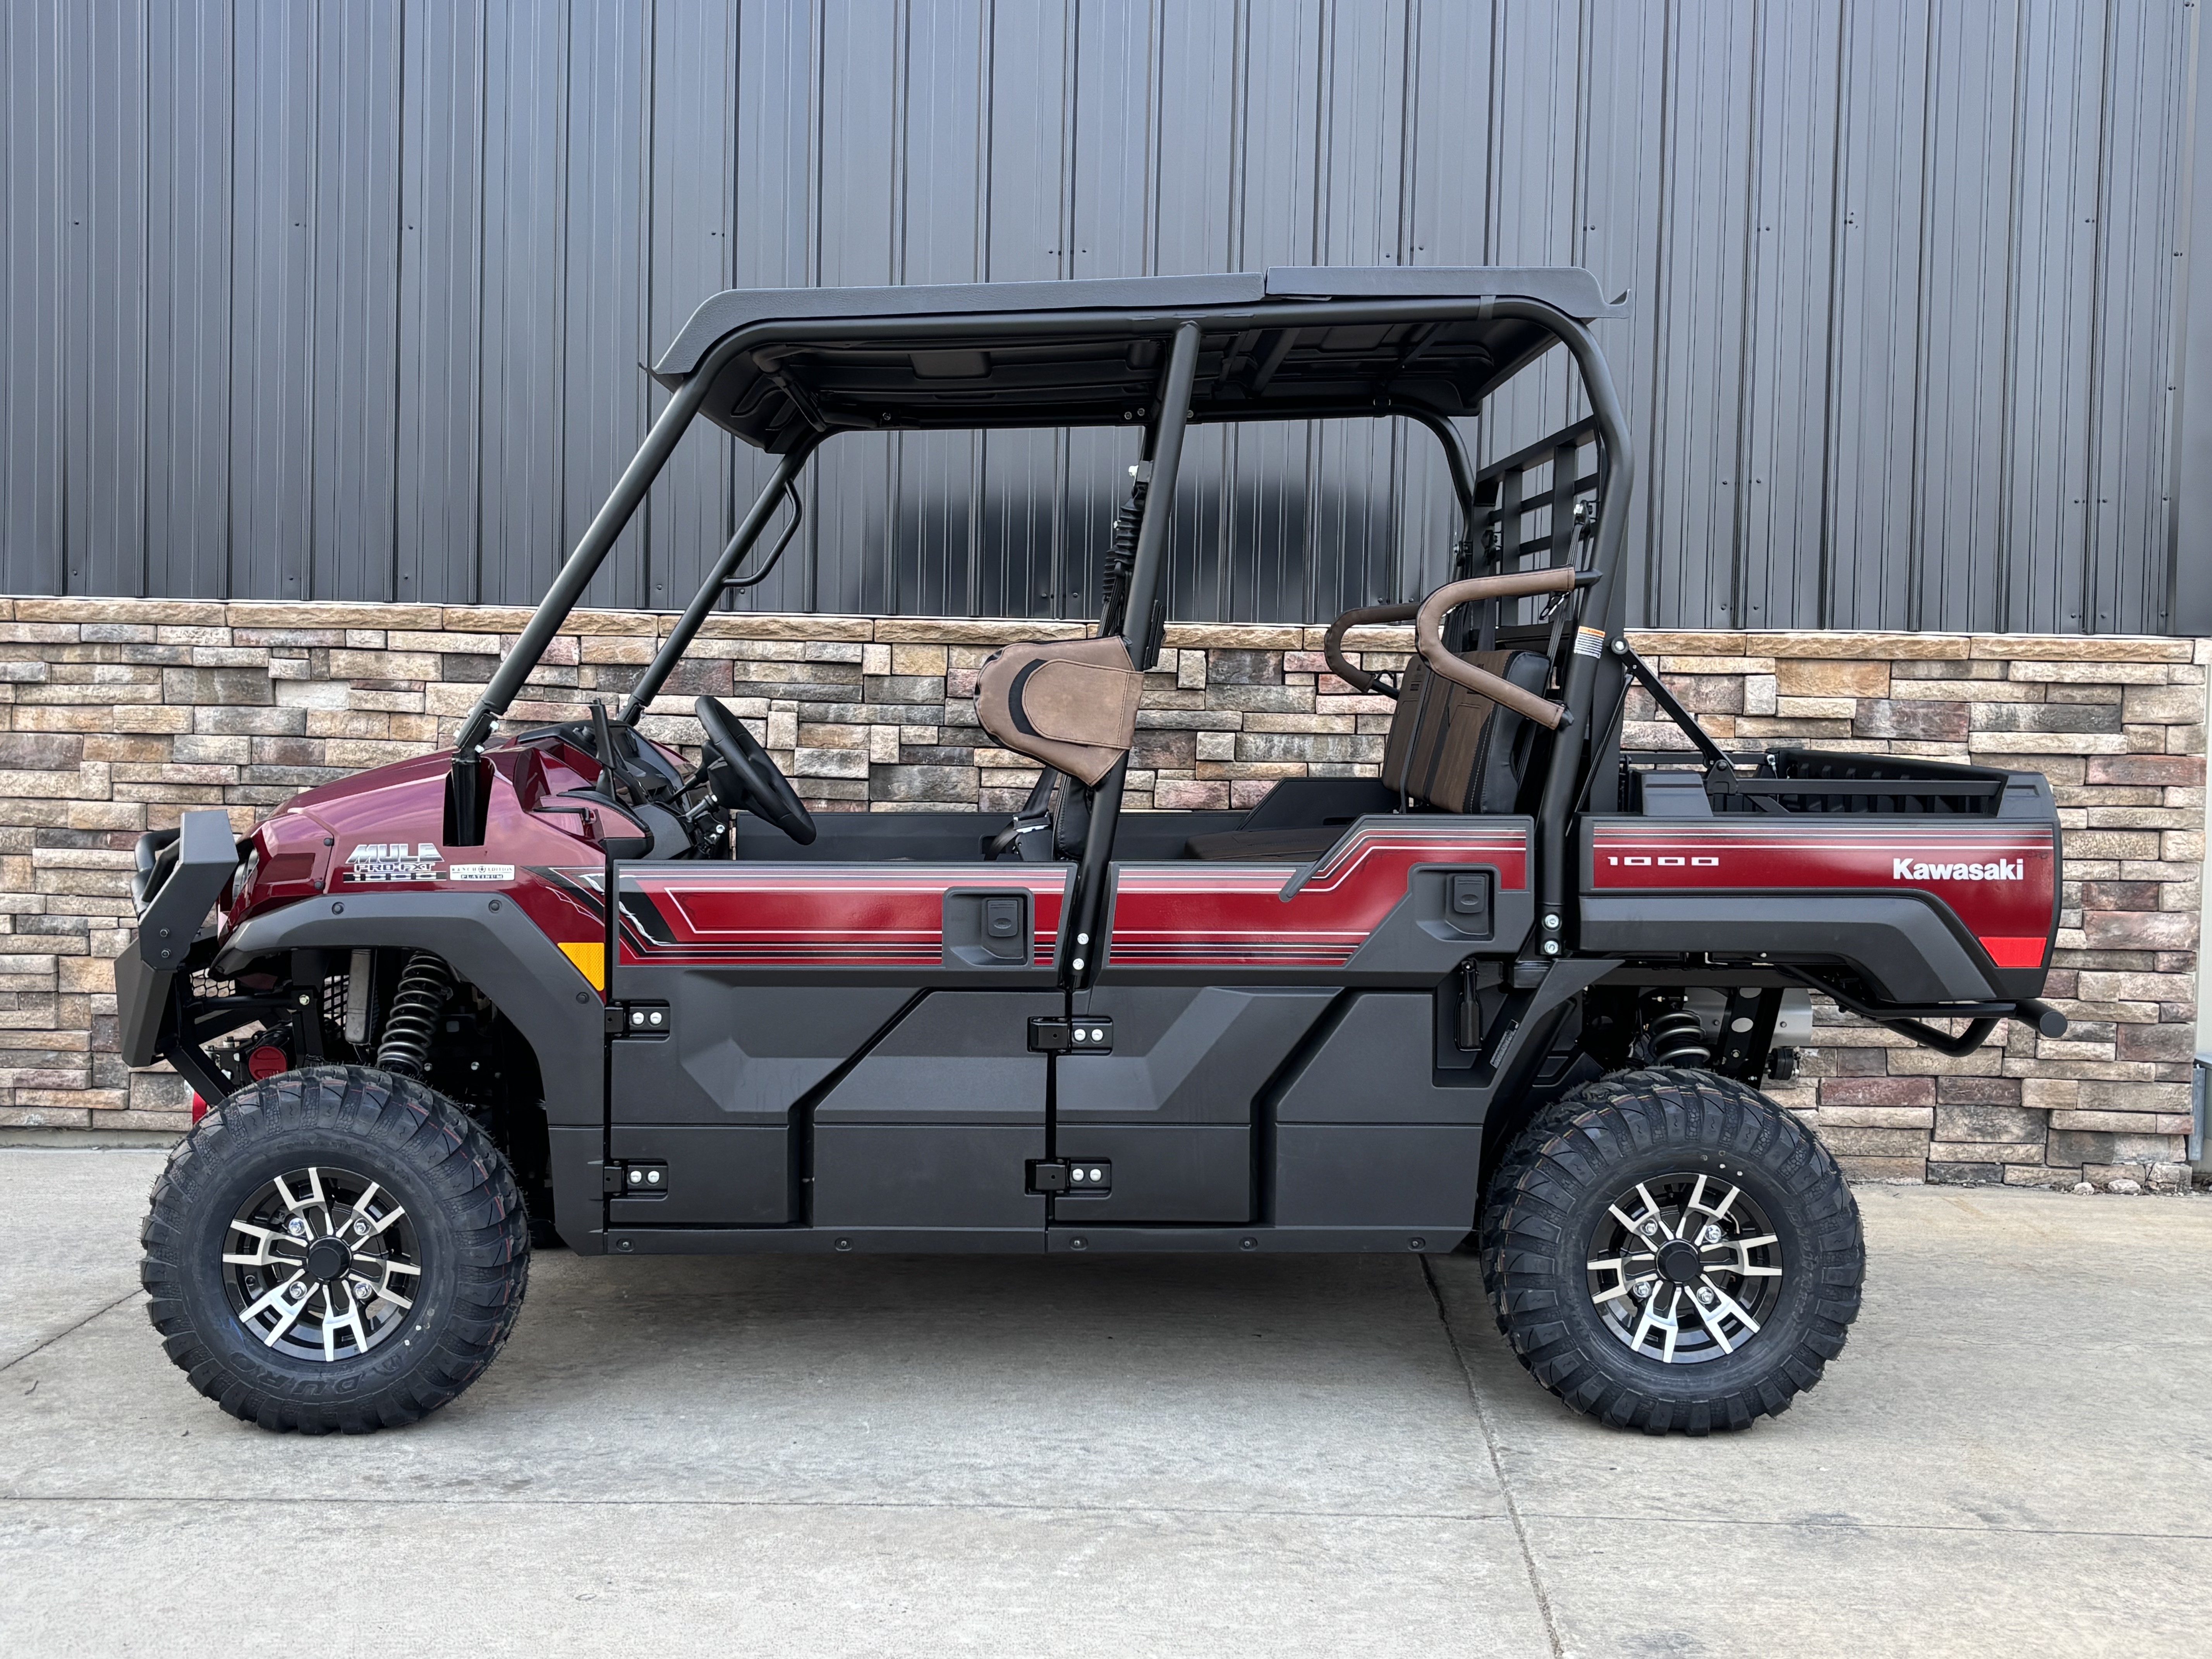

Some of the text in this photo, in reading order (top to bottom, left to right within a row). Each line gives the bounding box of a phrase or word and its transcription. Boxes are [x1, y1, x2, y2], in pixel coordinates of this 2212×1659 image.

[345, 843, 445, 864] MULE
[1607, 857, 1719, 866] 1000
[353, 873, 437, 881] 1000
[1893, 858, 2024, 881] Kawasaki
[229, 1352, 366, 1395] DURO
